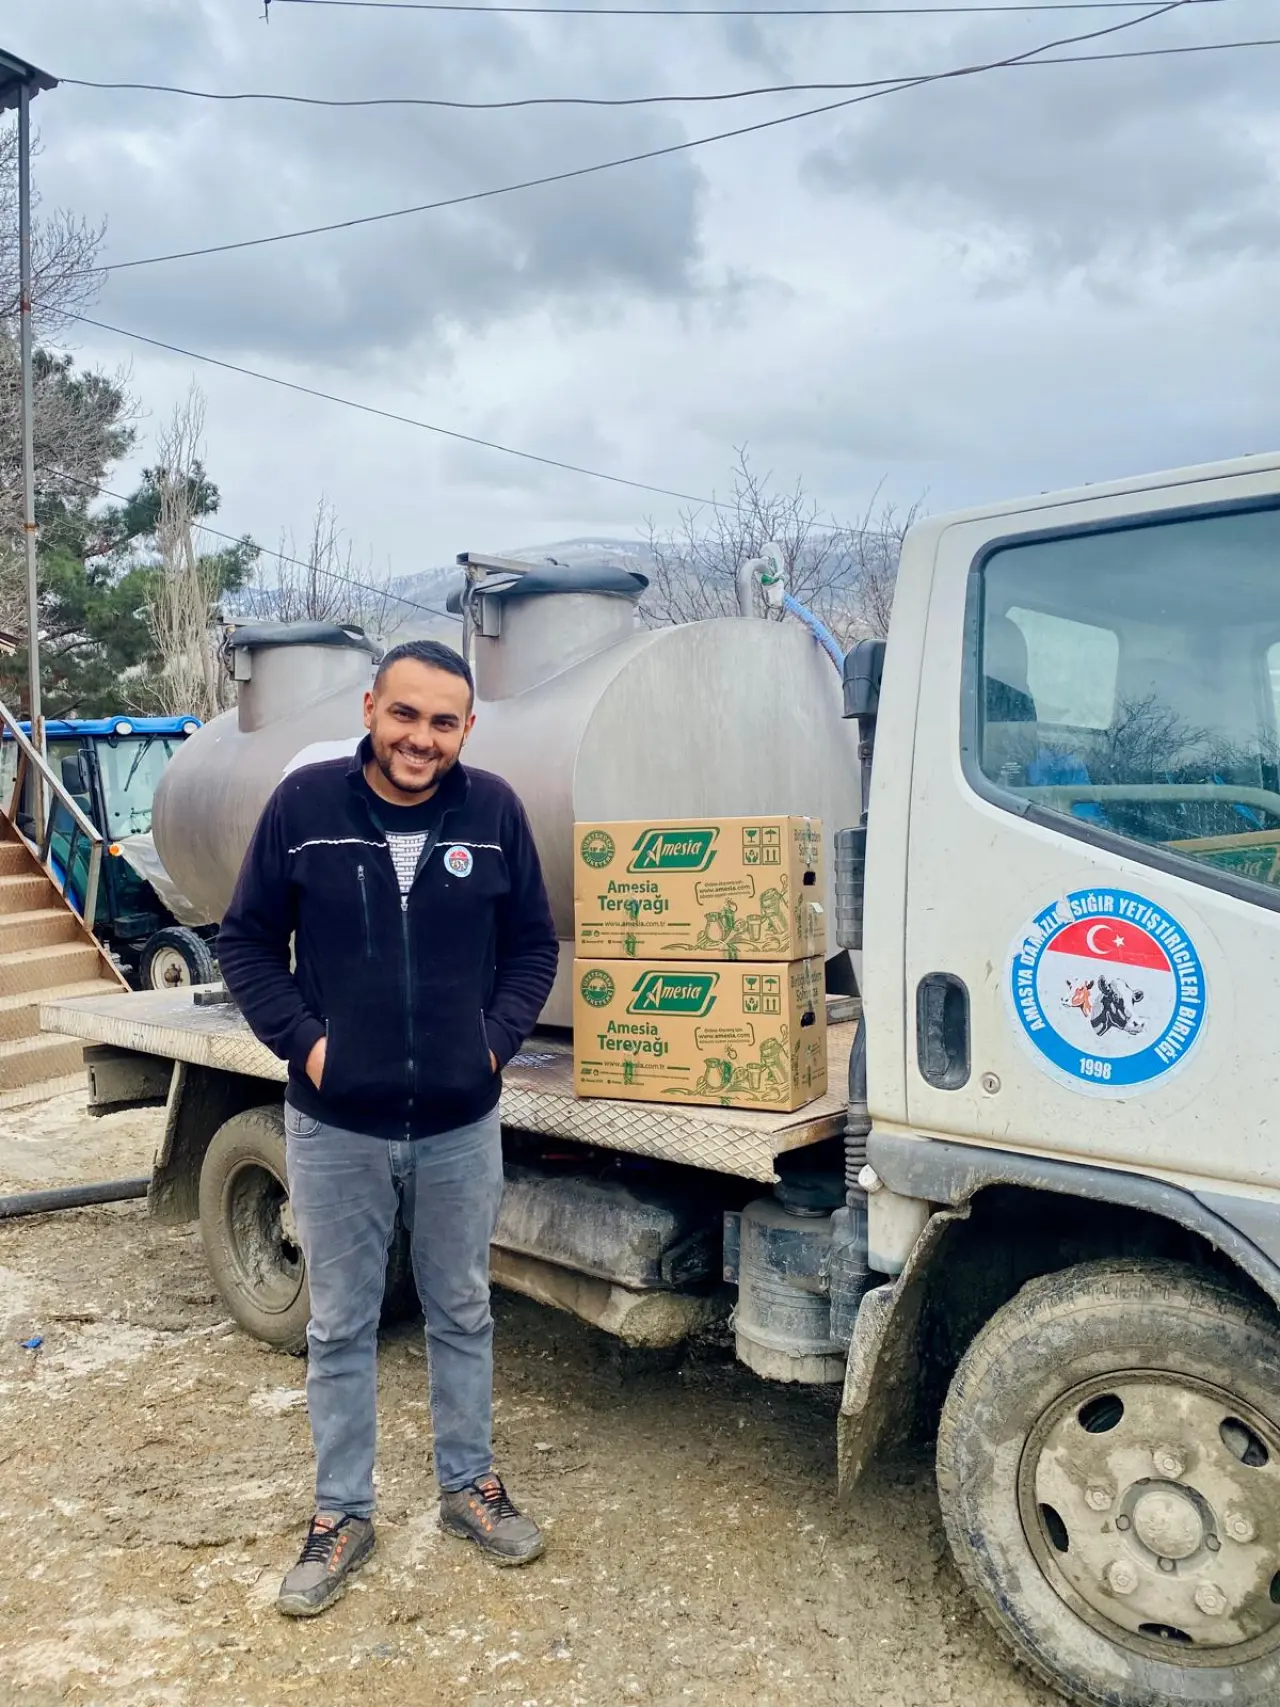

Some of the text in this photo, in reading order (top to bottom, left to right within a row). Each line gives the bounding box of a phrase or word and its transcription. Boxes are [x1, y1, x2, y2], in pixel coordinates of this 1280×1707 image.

[643, 835, 703, 866] Amesia
[607, 879, 659, 894] Amesia
[1071, 893, 1114, 917] SIĞIR
[1119, 898, 1201, 1004] YETİŞTİRİCİLERİ
[642, 977, 702, 1008] Amesia
[1018, 968, 1046, 1031] AMASYA
[607, 1020, 658, 1036] Amesia
[1154, 1005, 1198, 1064] BİRLİĞİ
[597, 1034, 669, 1057] Tereyağı
[1079, 1058, 1112, 1080] 1998
